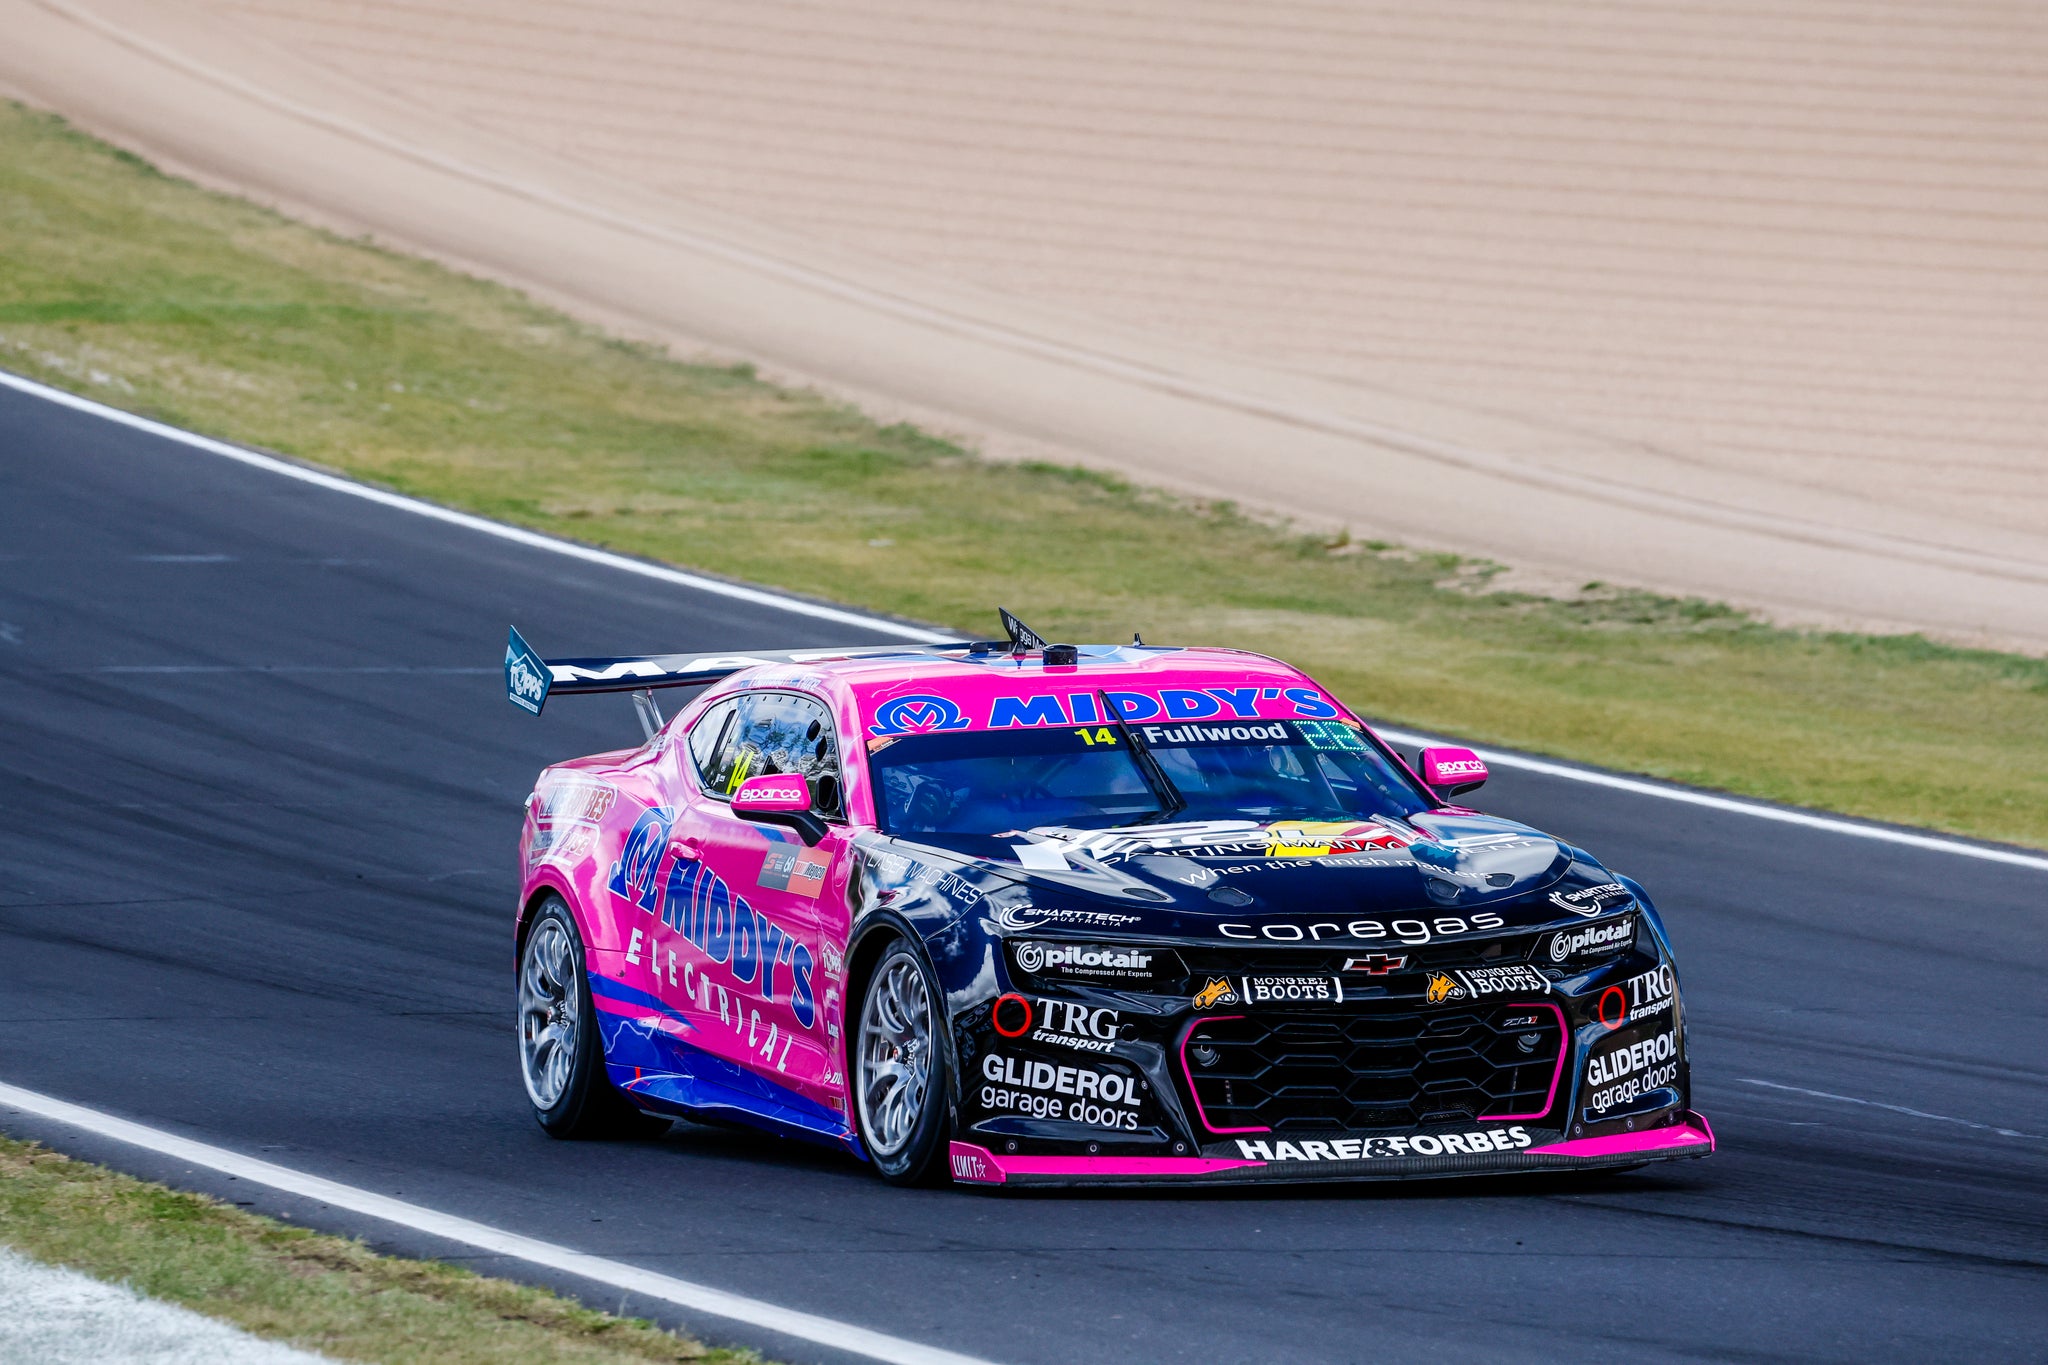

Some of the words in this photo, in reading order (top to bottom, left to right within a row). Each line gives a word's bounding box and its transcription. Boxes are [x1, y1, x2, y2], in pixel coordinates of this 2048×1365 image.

[986, 688, 1338, 728] MIDDY'S
[1074, 728, 1117, 746] 14
[1143, 723, 1289, 743] Fullwood
[1436, 760, 1484, 773] sparco
[740, 788, 801, 802] sparco
[905, 861, 984, 905] MACHINES
[1180, 864, 1262, 886] When
[1265, 860, 1312, 870] the
[1316, 857, 1390, 867] finish
[1395, 859, 1493, 879] matters
[1052, 916, 1121, 927] AUSTRALIA
[1218, 912, 1504, 945] coregas
[1570, 919, 1632, 953] pilotair
[661, 857, 815, 1030] MIDDY'S
[1045, 946, 1153, 968] pilotair
[1075, 967, 1115, 976] Compressed
[1128, 970, 1153, 978] Experts
[1253, 977, 1328, 986] MONGREL
[1469, 965, 1533, 980] MONGREL
[1480, 972, 1542, 994] BOOTS
[1628, 964, 1672, 1007] TRG
[625, 927, 793, 1073] ELECTRICAL
[1256, 986, 1330, 999] BOOTS
[1037, 997, 1120, 1040] TRG
[1032, 1029, 1115, 1053] transport
[1587, 1031, 1677, 1087] GLIDEROL
[982, 1054, 1142, 1106] GLIDEROL
[1591, 1078, 1640, 1114] garage
[1642, 1061, 1677, 1092] doors
[981, 1086, 1063, 1120] garage
[1069, 1098, 1139, 1131] doors
